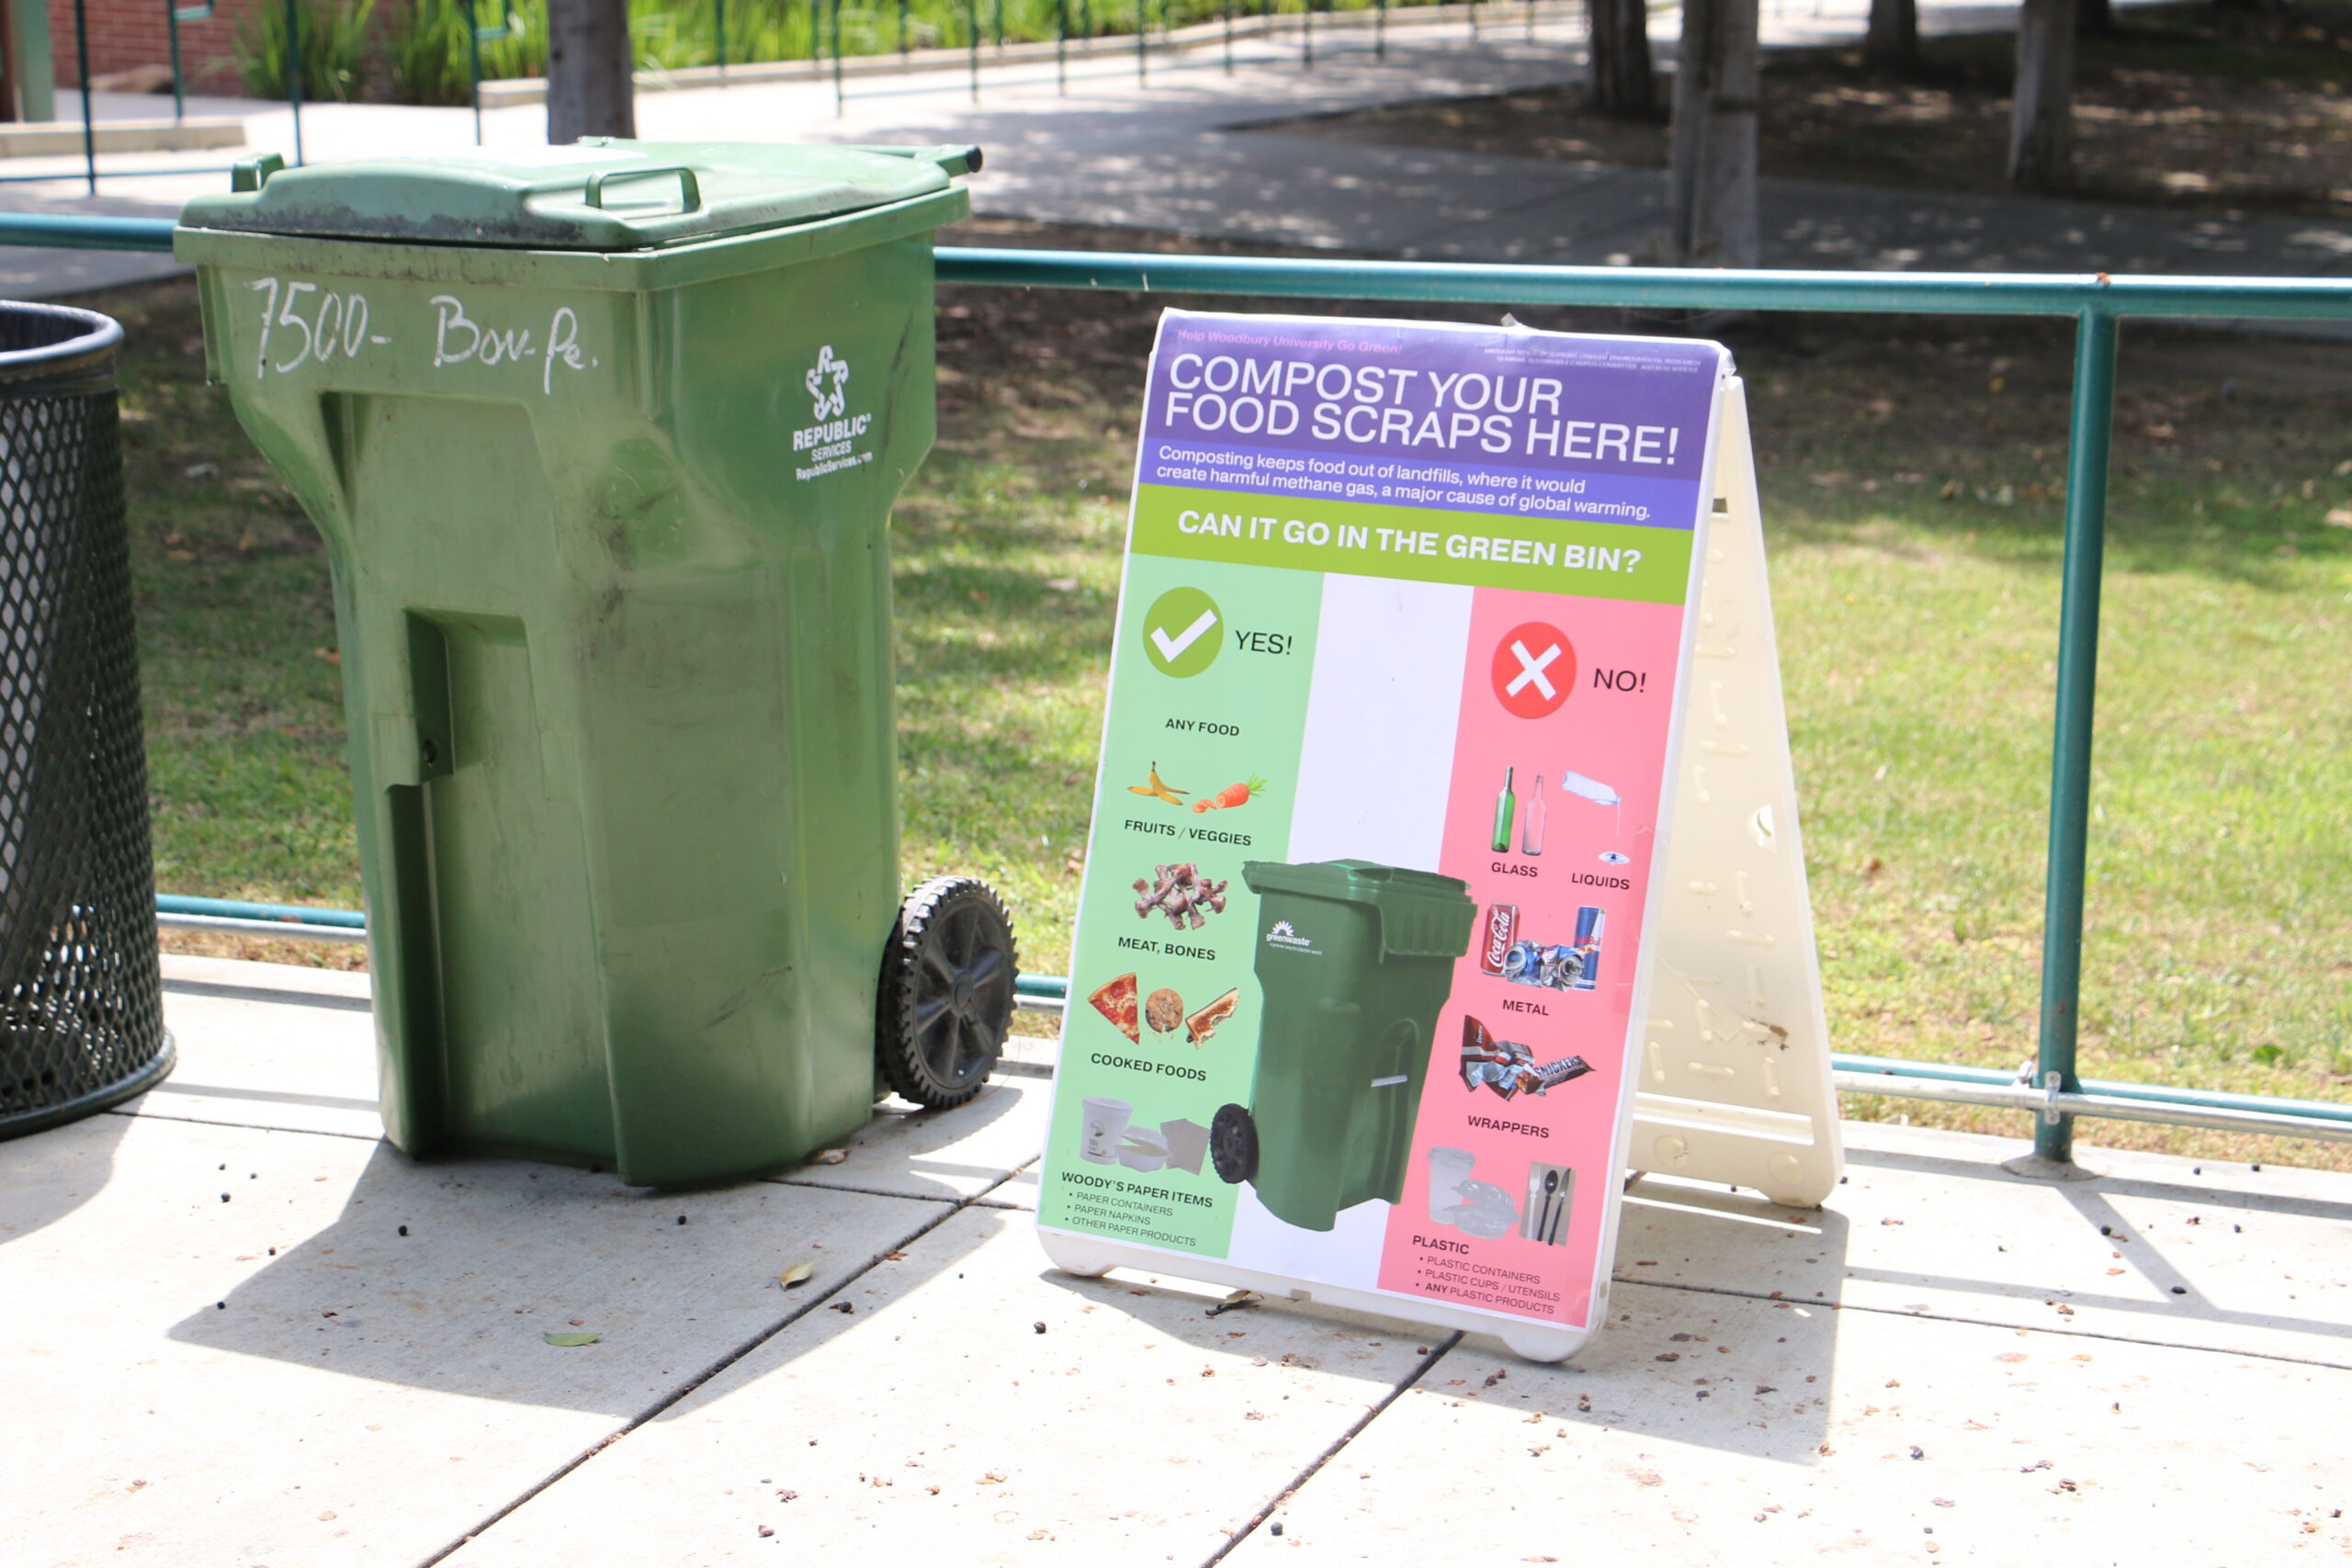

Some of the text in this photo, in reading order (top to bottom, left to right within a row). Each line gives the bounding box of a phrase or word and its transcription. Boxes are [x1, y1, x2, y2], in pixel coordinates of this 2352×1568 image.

[1177, 330, 1403, 354] Help Woodbury University Go Green!
[1169, 352, 1563, 415] COMPOST YOUR
[793, 415, 866, 451] REPUBLIC
[1164, 391, 1679, 466] FOOD SCRAPS HERE!
[811, 440, 852, 462] SERVICES
[1158, 446, 1586, 494] Composting keeps food out of landfills, where it would
[1156, 464, 1651, 520] create harmful methane gas, a major cause of global warming.
[1178, 510, 1642, 575] CAN IT GO IN THE GREEN BIN?
[1235, 630, 1293, 655] YES!
[1593, 668, 1646, 694] NO!
[1165, 718, 1239, 737] ANY FOOD
[1124, 819, 1175, 836] FRUITS
[1189, 829, 1251, 846] VEGGIES
[1491, 861, 1538, 877] GLASS
[1571, 872, 1630, 890] LIQUIDS
[1118, 936, 1216, 961] MEAT, BONES
[1266, 933, 1310, 946] greenwaste
[1502, 999, 1550, 1016] METAL
[1091, 1053, 1206, 1081] COOKED FOODS
[1532, 1056, 1582, 1078] SNICKERS
[1467, 1115, 1550, 1138] WRAPPERS
[1062, 1171, 1214, 1209] WOODY'S PAPER ITEMS
[1074, 1204, 1151, 1225] PAPER NAPKINS
[1076, 1191, 1173, 1217] PAPER CONTAINERS
[1072, 1216, 1196, 1247] OTHER PAPER PRODUCTS
[1412, 1235, 1470, 1255] PLASTIC
[1427, 1256, 1541, 1285] PLASTIC CONTAINERS
[1425, 1269, 1468, 1285] PLASTIC
[1470, 1277, 1499, 1291] CUPS
[1509, 1285, 1560, 1303] UTENSILS
[1425, 1282, 1555, 1314] ANY PLASTIC PRODUCTS
